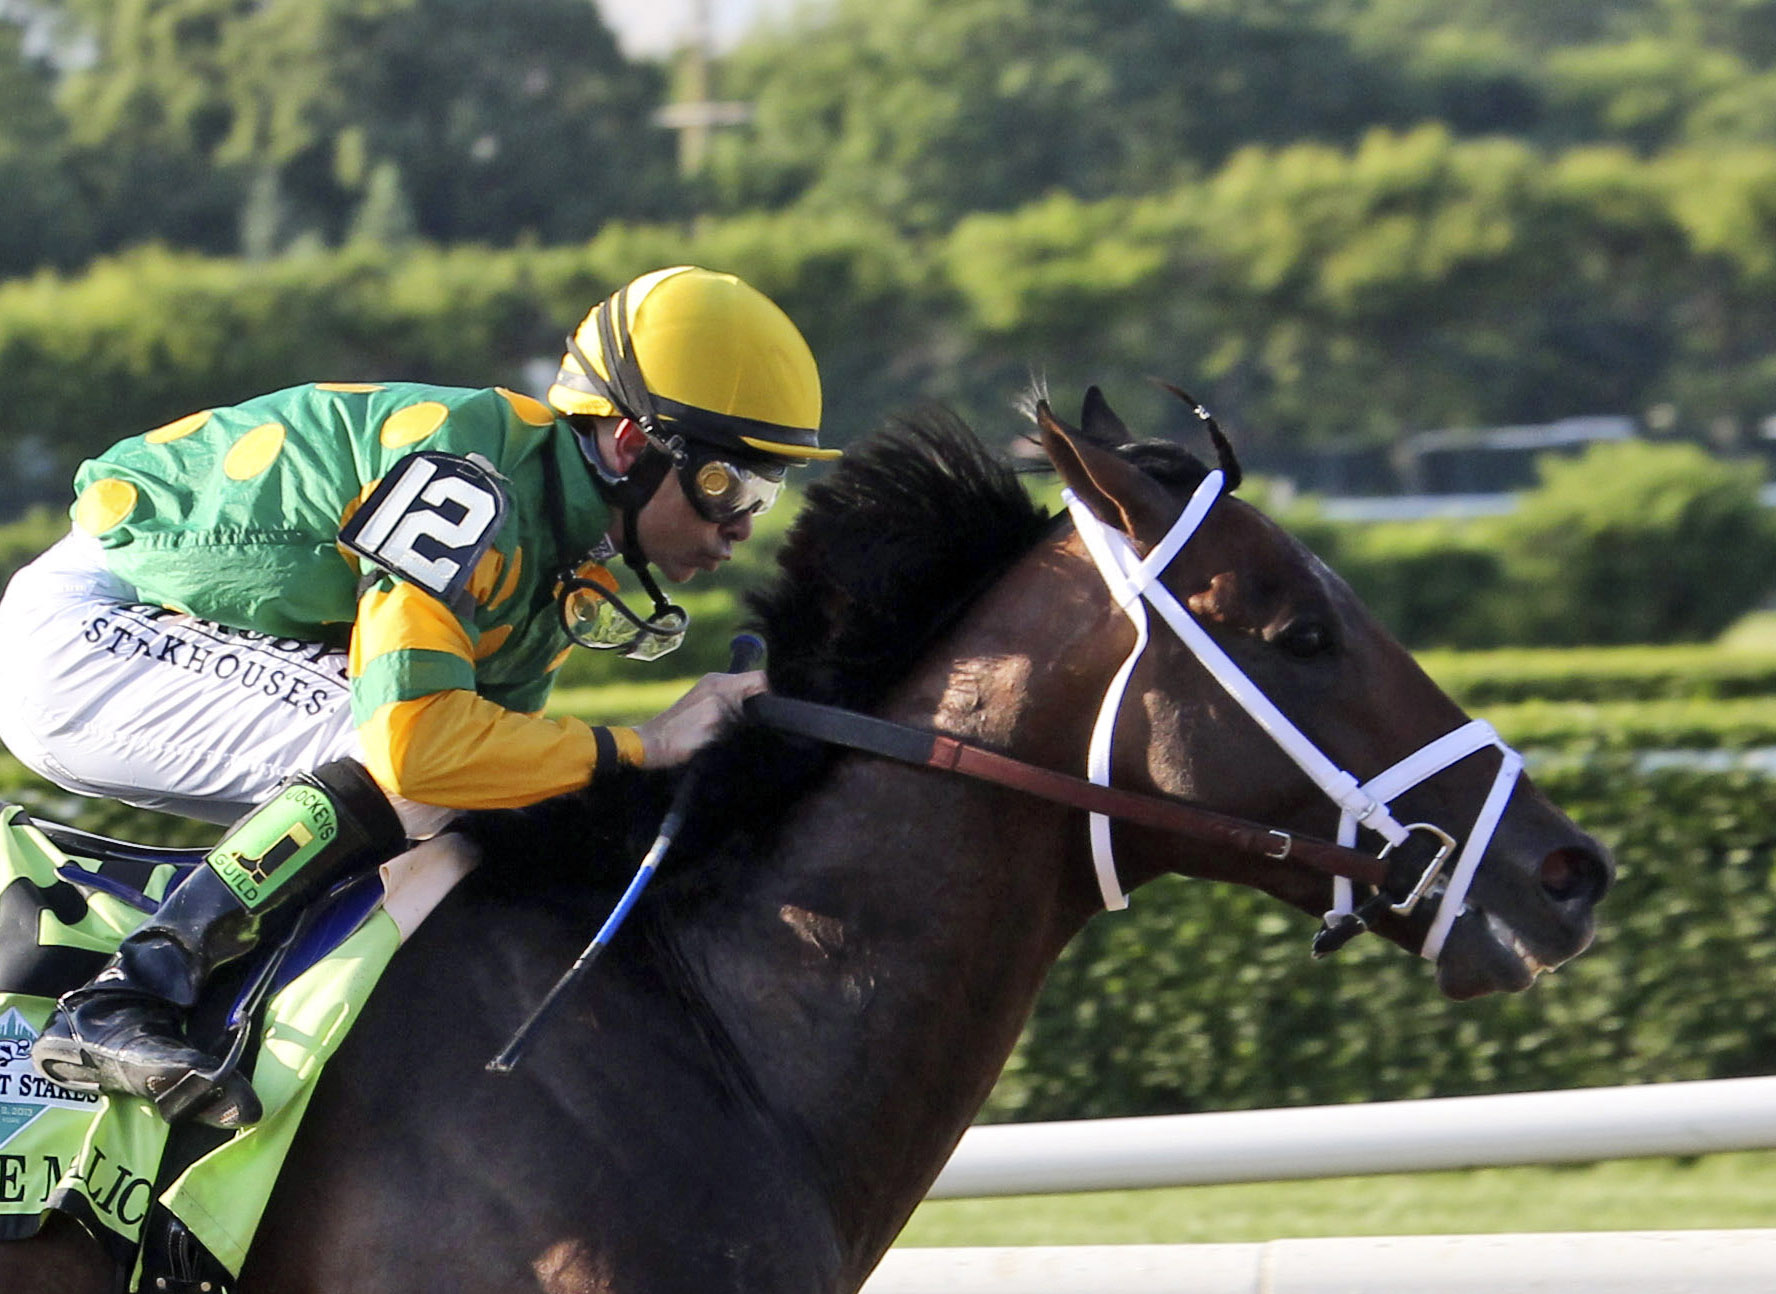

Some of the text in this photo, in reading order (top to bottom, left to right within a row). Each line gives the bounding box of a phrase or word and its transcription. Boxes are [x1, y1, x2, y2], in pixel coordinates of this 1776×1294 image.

[354, 457, 497, 593] 12
[286, 790, 334, 841] JOCKEYS
[215, 855, 258, 902] GUILD
[19, 1074, 100, 1103] STAKES
